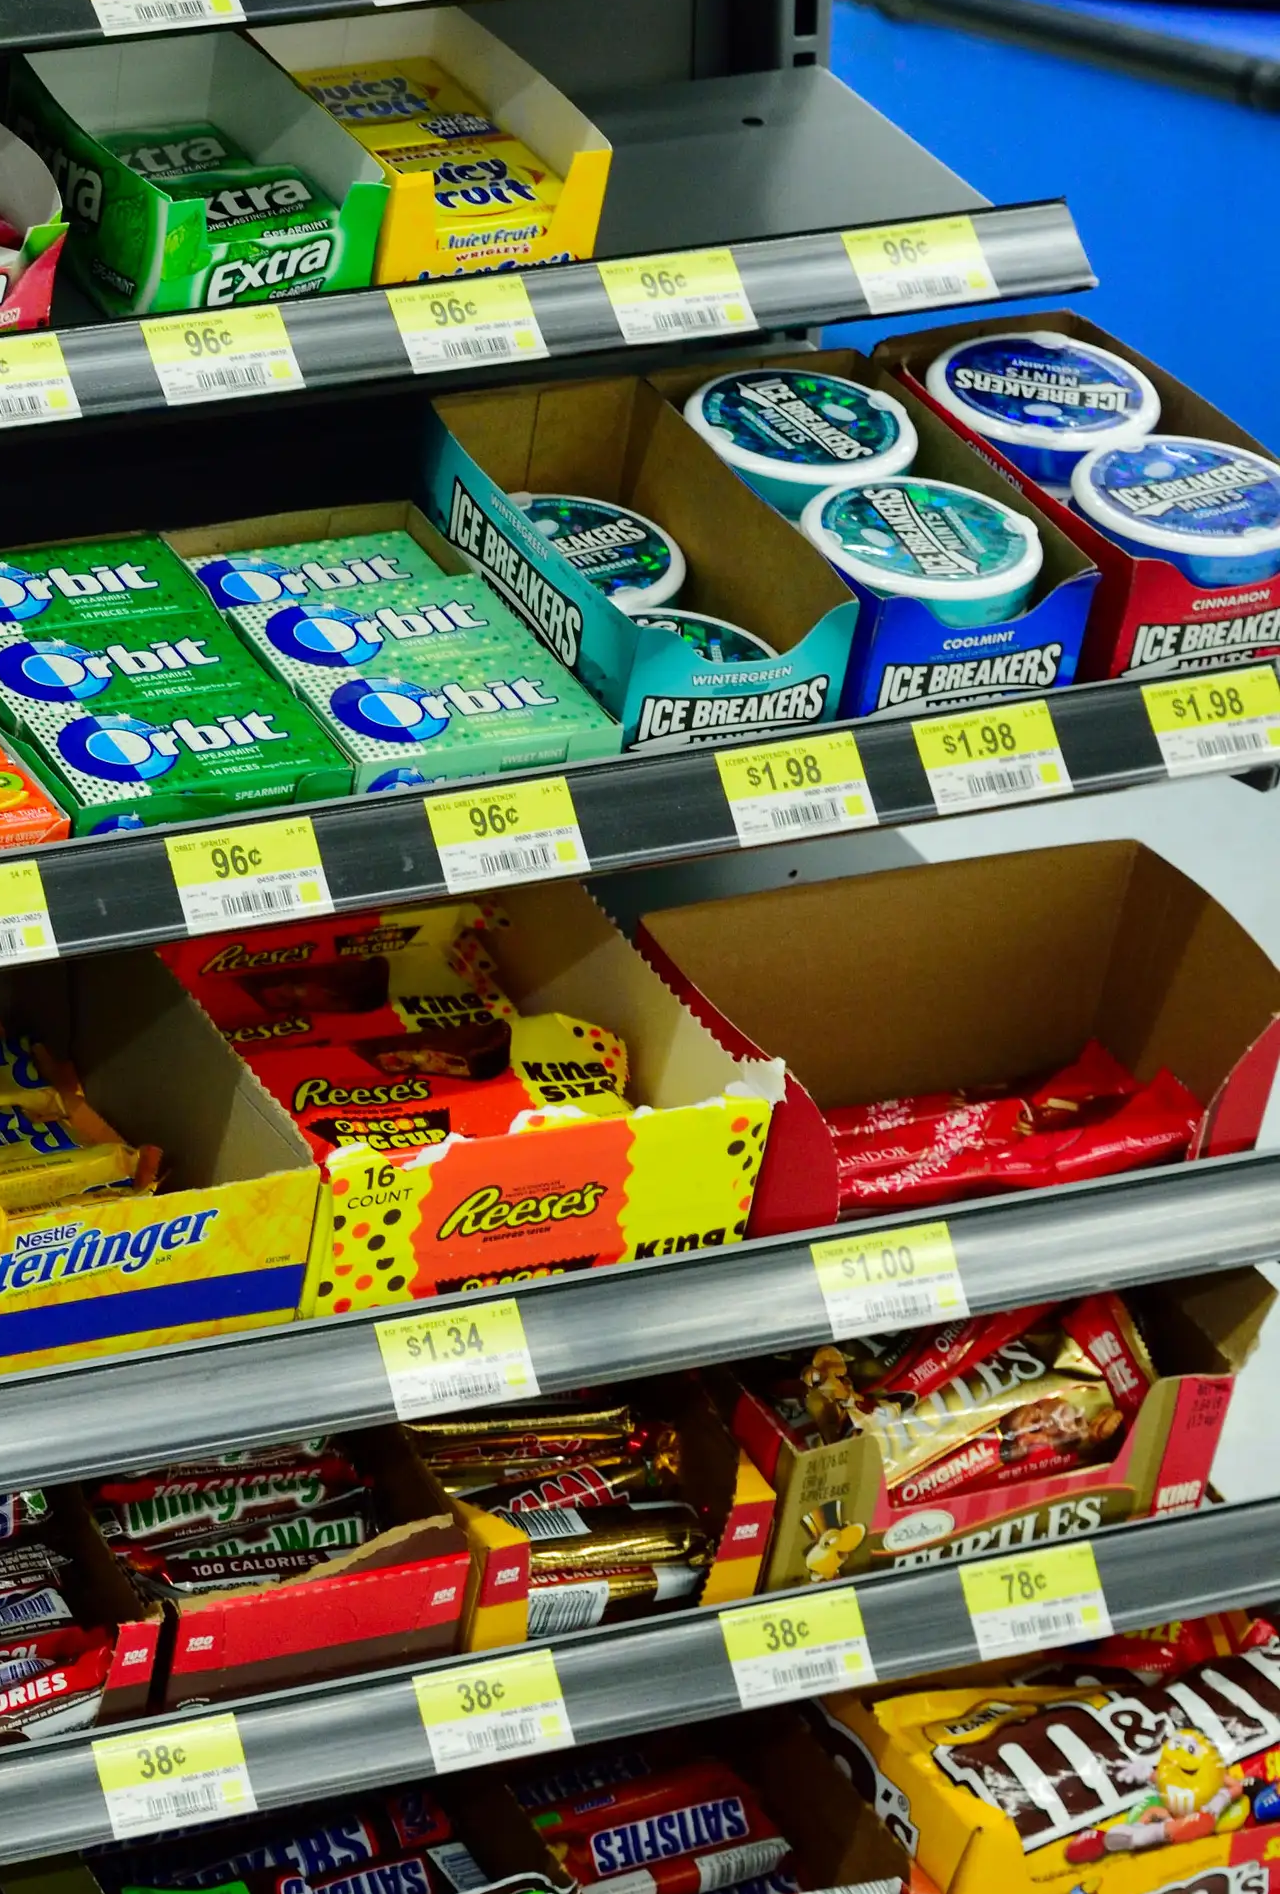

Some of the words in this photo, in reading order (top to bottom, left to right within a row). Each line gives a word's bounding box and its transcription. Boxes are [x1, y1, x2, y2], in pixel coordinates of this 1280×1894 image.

[882, 235, 932, 266] 96¢
[639, 271, 688, 298] 96¢
[428, 298, 478, 325] 96¢
[183, 328, 233, 357] 96¢
[68, 593, 131, 606] SPEARMINT
[1191, 588, 1272, 611] CINNAMON
[941, 630, 1016, 653] COOLMINT
[881, 663, 928, 711] ICE
[929, 643, 1063, 695] BREAKERS
[639, 695, 689, 740] ICE
[691, 678, 826, 731] BREAKERS
[1170, 687, 1244, 723] $1.98
[943, 724, 1017, 758] $1.98
[746, 754, 823, 791] $1.98
[469, 802, 521, 837] 96¢
[211, 844, 263, 879] 96¢
[362, 1164, 396, 1189] 16
[347, 1186, 413, 1212] COUNT
[437, 1182, 609, 1241] Reese's
[841, 1248, 916, 1282] $1.00
[406, 1323, 484, 1359] $1.34
[1000, 1568, 1048, 1602] 78¢
[761, 1618, 810, 1652] 38¢
[455, 1678, 506, 1714] 38¢
[135, 1744, 188, 1780] 38¢
